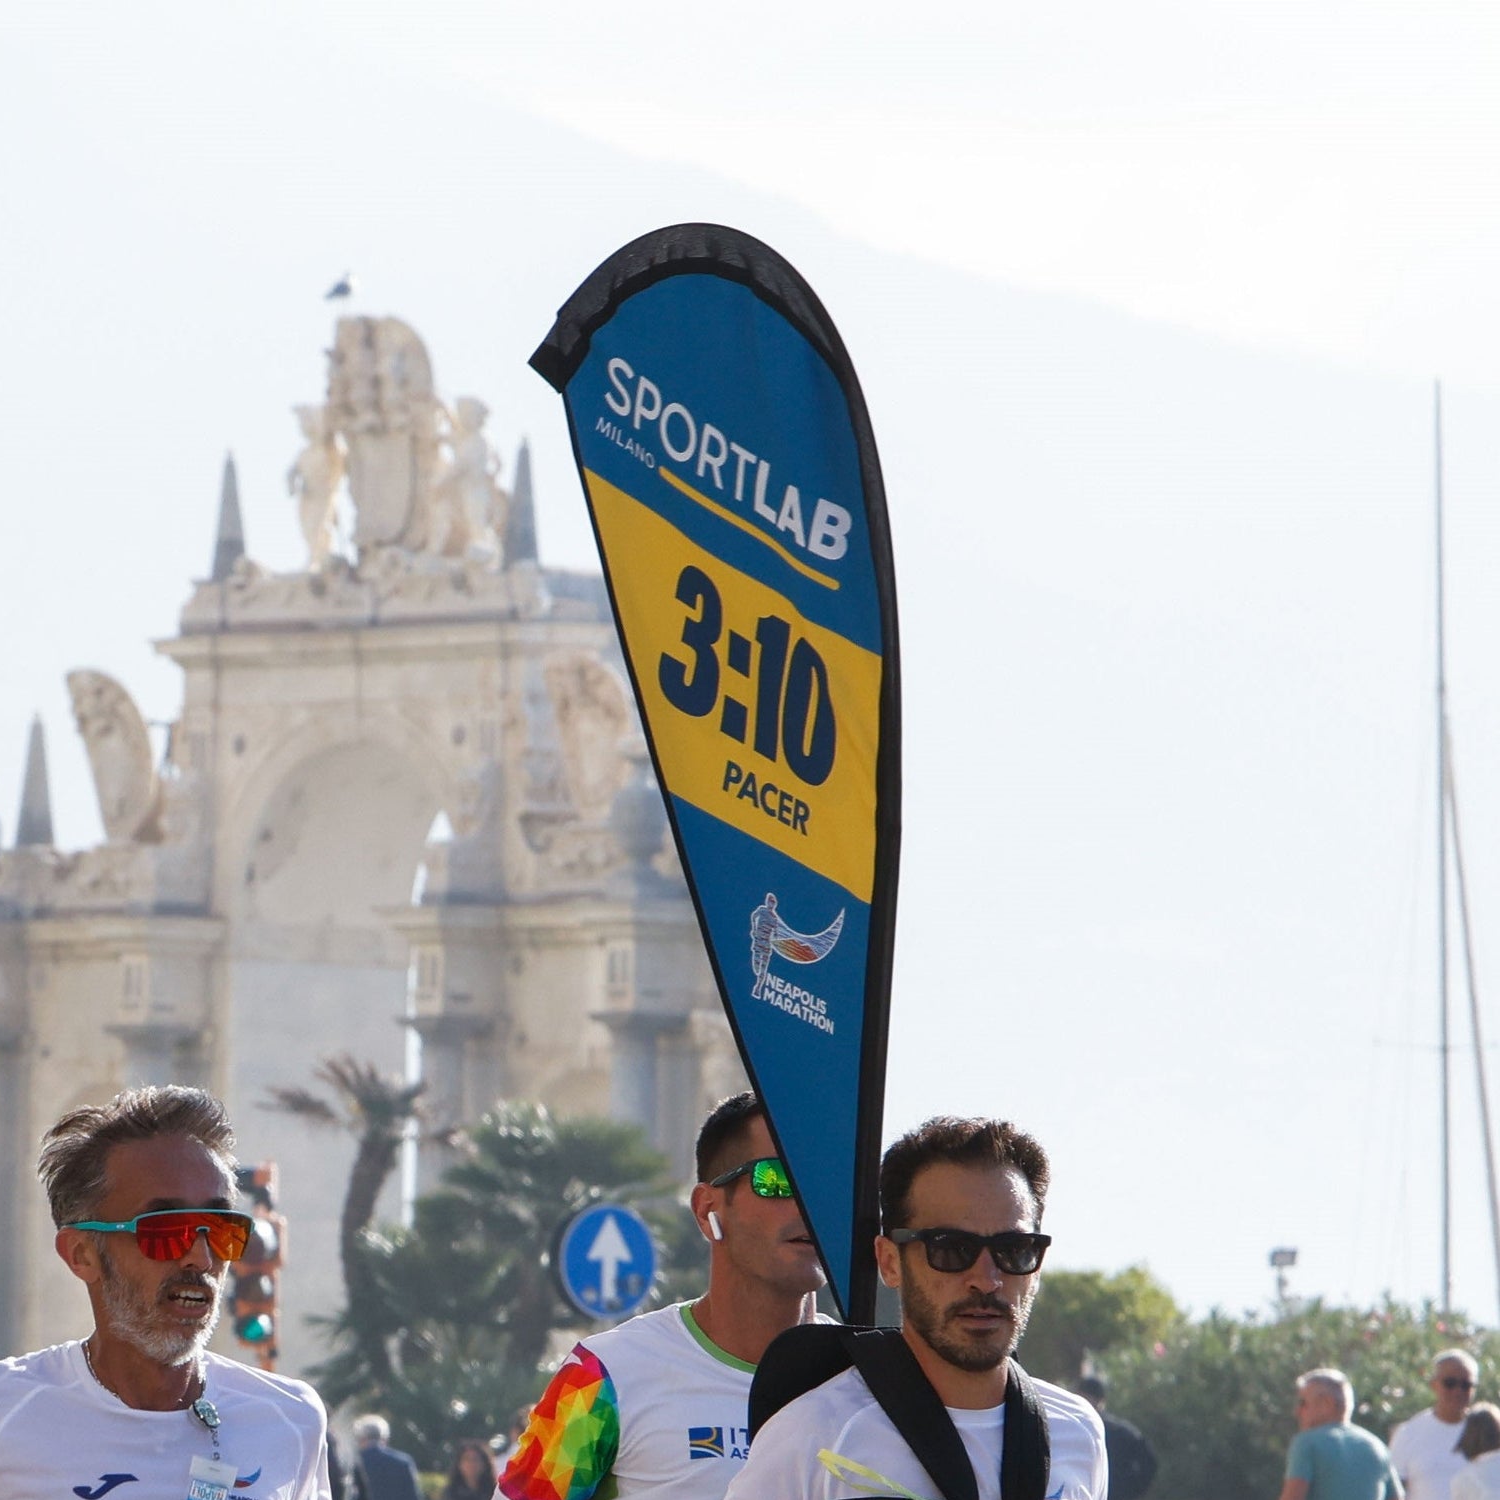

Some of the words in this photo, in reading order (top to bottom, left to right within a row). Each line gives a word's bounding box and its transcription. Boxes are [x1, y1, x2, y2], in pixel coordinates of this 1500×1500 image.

[595, 416, 655, 469] MILANO
[604, 357, 852, 560] SPORTLAB
[658, 565, 836, 786] 3:10
[722, 760, 810, 836] PACER
[763, 987, 834, 1035] MARATHON
[766, 972, 827, 1014] NEAPOLIS
